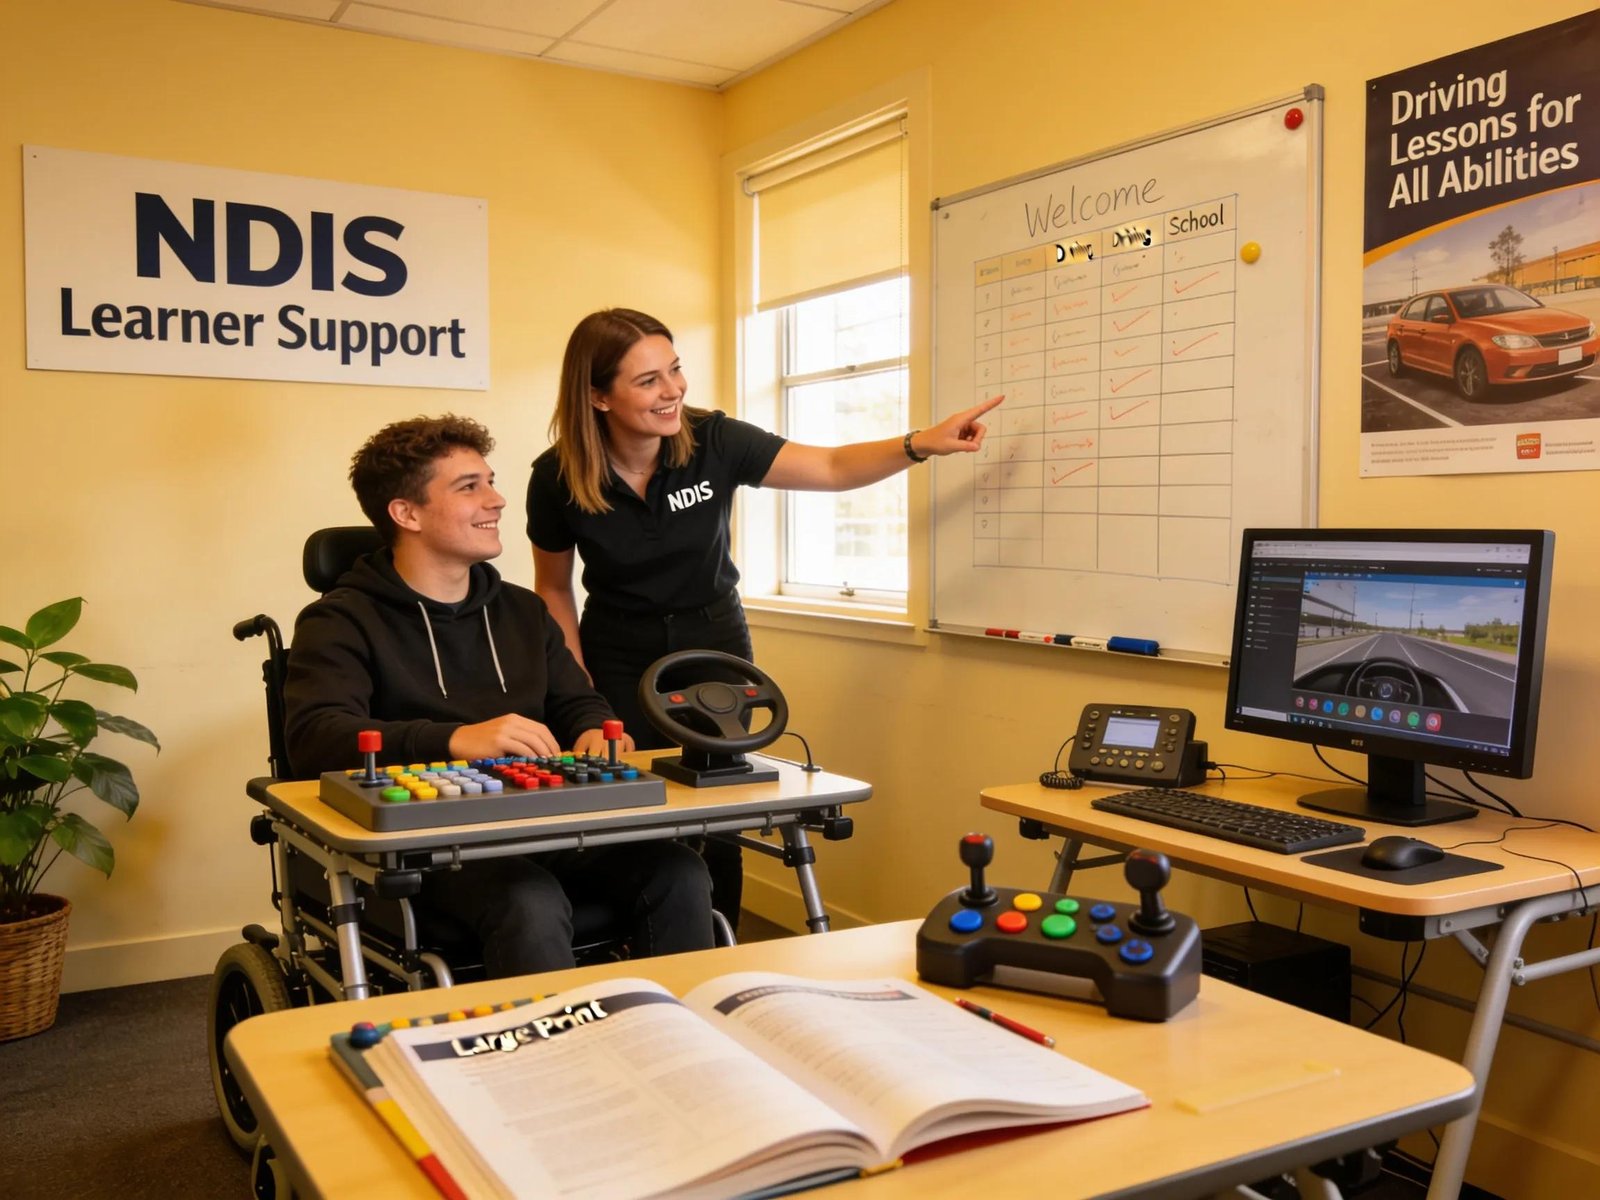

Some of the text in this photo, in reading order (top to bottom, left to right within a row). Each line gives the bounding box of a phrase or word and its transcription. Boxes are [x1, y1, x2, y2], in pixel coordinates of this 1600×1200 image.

[1390, 92, 1582, 166] Lessons for
[1391, 69, 1508, 126] Driving
[1388, 141, 1580, 209] All Abilities
[1025, 178, 1165, 238] Welcome
[1169, 203, 1224, 236] School
[134, 191, 408, 297] NDIS
[61, 287, 466, 367] Learner Support
[667, 480, 714, 512] NDIS
